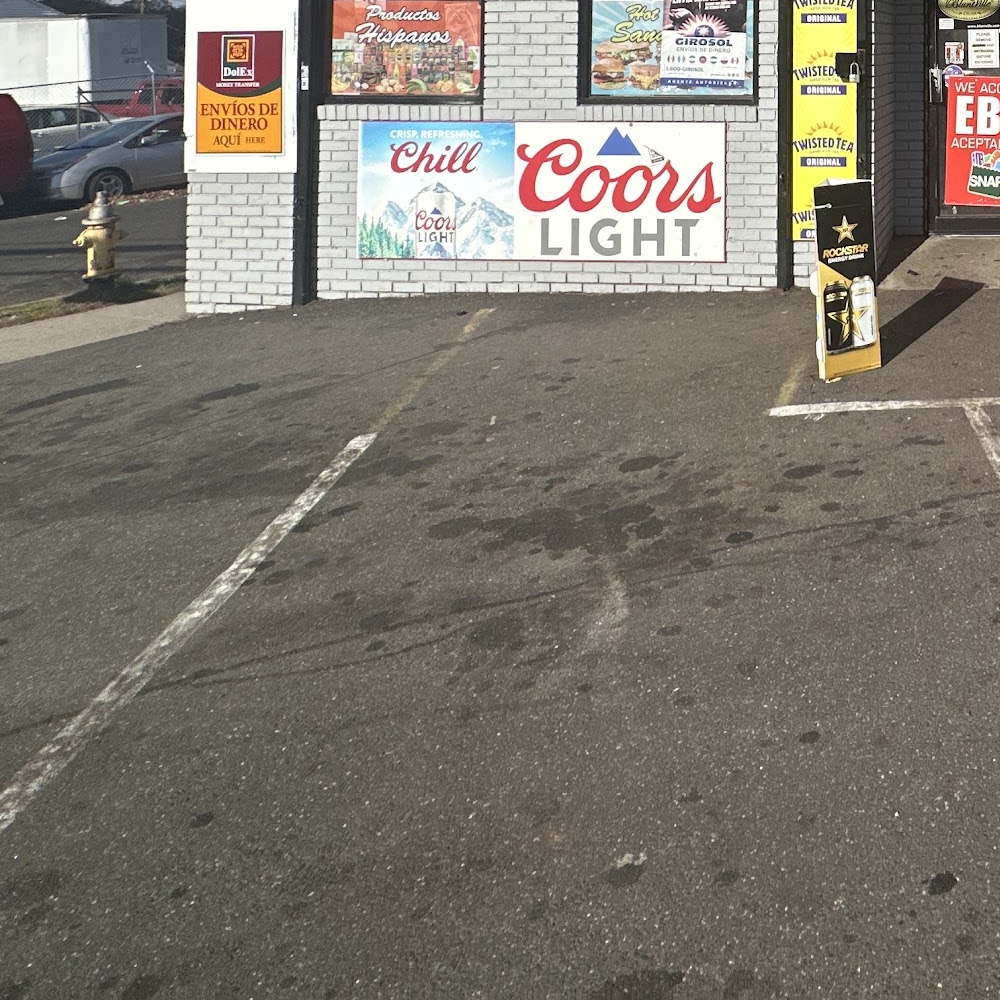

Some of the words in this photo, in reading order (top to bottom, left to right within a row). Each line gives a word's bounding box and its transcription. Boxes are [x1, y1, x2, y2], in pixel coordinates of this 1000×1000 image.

[366, 4, 441, 21] Productos
[626, 4, 661, 22] Hot
[806, 14, 842, 23] ORIGINAL
[355, 22, 451, 48] Hispanos
[675, 38, 732, 46] GIROSOL
[223, 67, 253, 77] DolEx
[793, 65, 835, 81] TWISTED
[806, 85, 842, 94] ORIGINAL
[955, 82, 975, 93] WE
[200, 100, 255, 116] ENVÍOS
[258, 103, 279, 116] DE
[210, 117, 268, 131] DINERO
[212, 132, 241, 147] AQUÍ
[245, 136, 266, 144] HERE
[390, 130, 418, 139] CRISP.
[421, 129, 483, 139] REFRESHING.
[793, 137, 835, 153] TWISTED
[836, 137, 855, 153] TEA
[390, 140, 484, 174] Chill
[806, 157, 842, 166] ORIGINAL
[516, 138, 722, 213] Coors
[418, 231, 454, 243] LIGHT
[540, 218, 700, 257] LIGHT
[822, 243, 869, 259] ROCKSTAR
